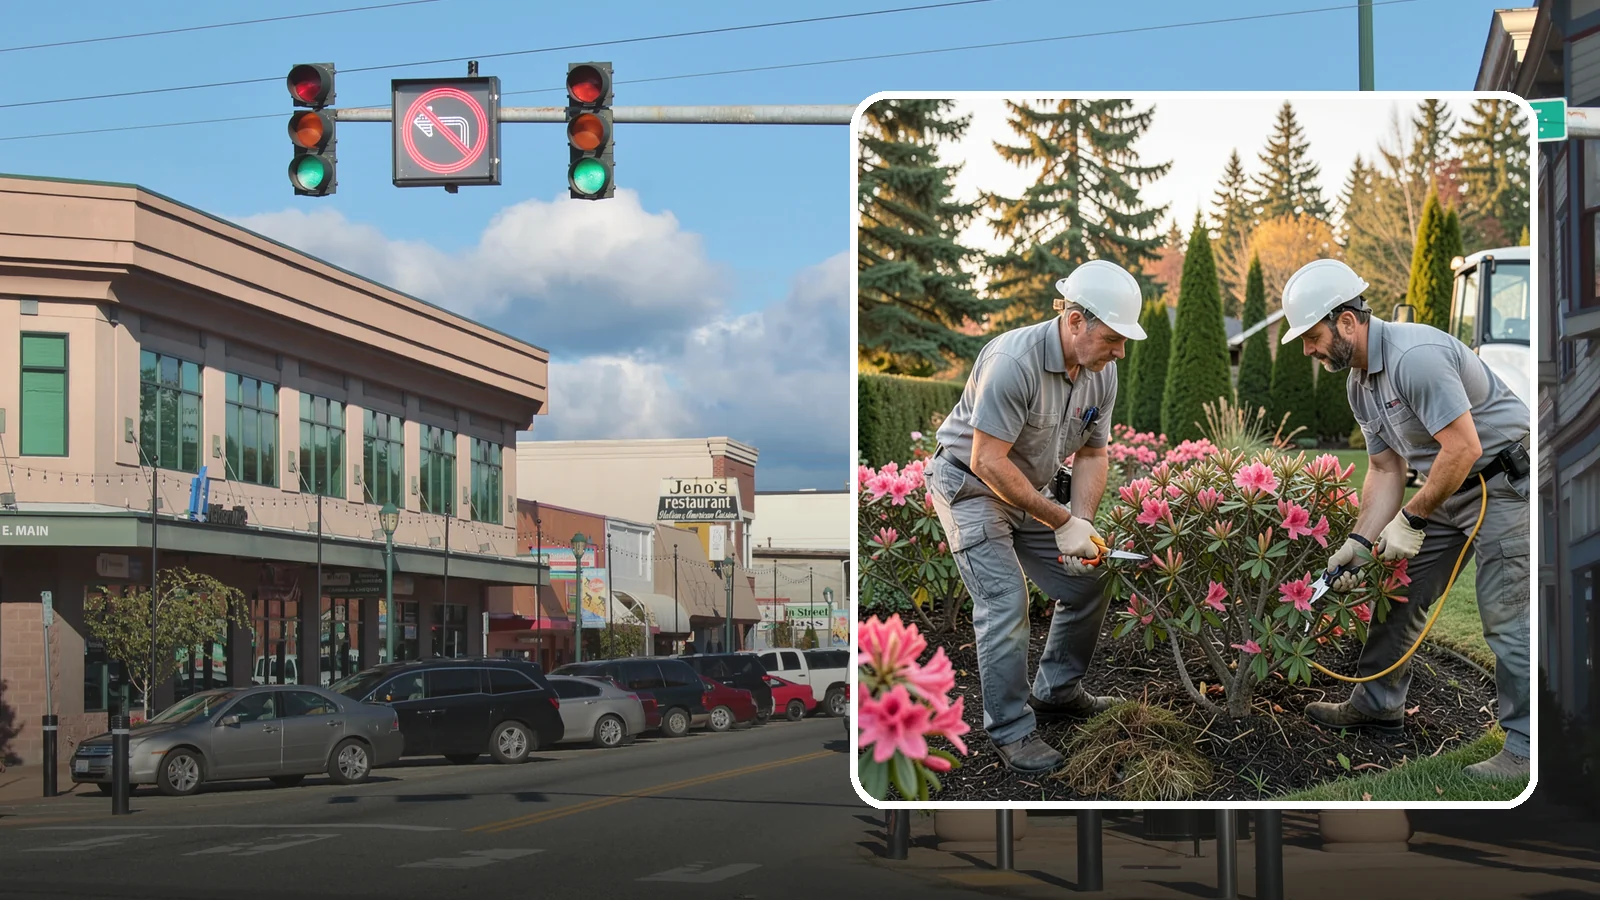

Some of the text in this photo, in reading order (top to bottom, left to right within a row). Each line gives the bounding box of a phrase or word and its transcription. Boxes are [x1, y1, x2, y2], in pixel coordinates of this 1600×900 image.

[669, 480, 728, 495] Jeno's
[665, 496, 731, 509] restaurant
[659, 510, 682, 520] Italian
[686, 510, 715, 520] American
[715, 510, 738, 520] Cuisine
[2, 525, 49, 536] E. MAIN
[785, 607, 795, 617] in
[797, 607, 828, 617] Street
[790, 619, 824, 627] lass
